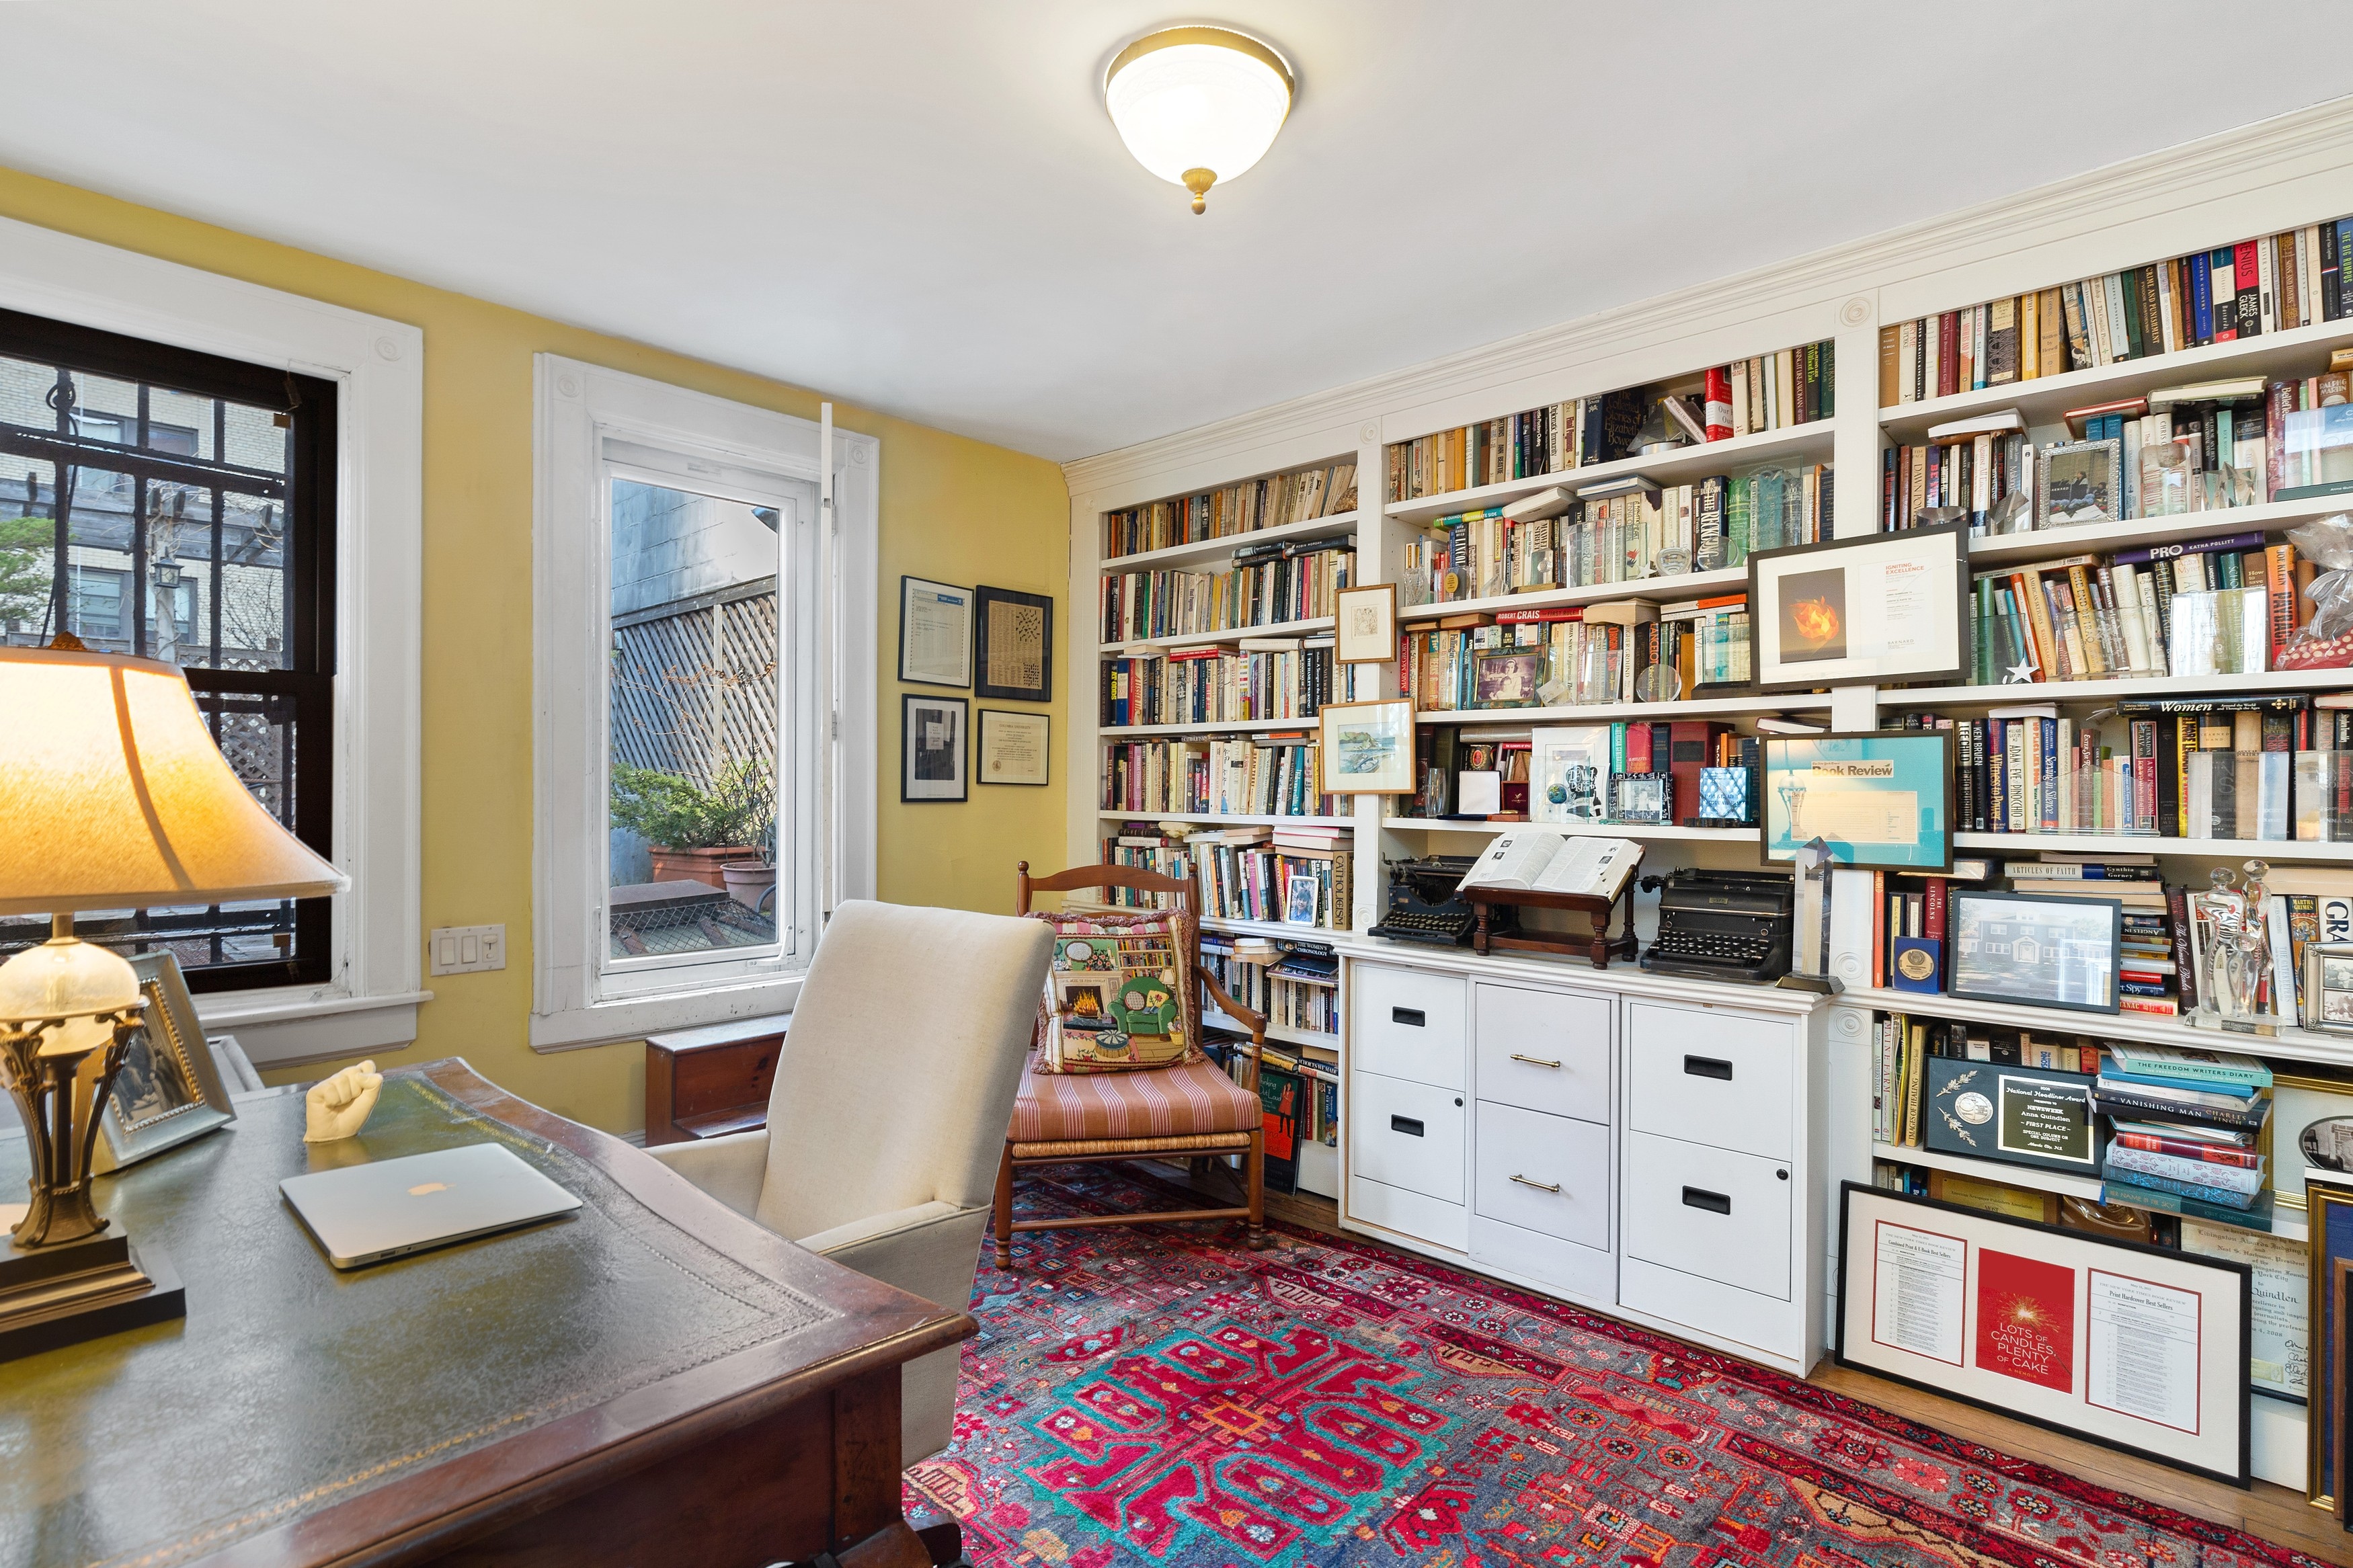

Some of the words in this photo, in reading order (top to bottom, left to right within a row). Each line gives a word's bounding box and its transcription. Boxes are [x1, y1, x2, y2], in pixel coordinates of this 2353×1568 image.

[2342, 231, 2350, 243] THE
[2343, 245, 2351, 257] BIG
[2344, 259, 2352, 284] RUMPUS
[2146, 267, 2154, 288] CRIME
[2150, 304, 2159, 343] PUNISHMENT
[2249, 294, 2258, 317] JAMES
[2321, 385, 2346, 395] MARTIN
[1550, 405, 1558, 430] Diplomatic
[1718, 405, 1729, 414] Our
[1914, 464, 1922, 491] DAWN
[1704, 494, 1714, 511] THE
[1701, 512, 1719, 558] RECKONING
[2151, 544, 2184, 559] PRO
[2276, 550, 2285, 563] JOE
[1886, 566, 1924, 575] EXCELLENCE
[2178, 565, 2201, 574] Myrer
[2276, 565, 2286, 585] KLEIN
[2074, 570, 2083, 587] THE
[2030, 577, 2039, 601] AMERICAN
[2155, 568, 2171, 610] PULITZER
[2077, 590, 2087, 606] END
[1517, 610, 1540, 620] CRAIS
[2034, 602, 2044, 624] SKETCHES
[2273, 591, 2292, 646] PAYBACK
[2084, 622, 2094, 643] IRAQ
[1649, 622, 1659, 665] LANCELOT
[2042, 644, 2053, 670] ISAACSON
[1111, 671, 1117, 680] AT
[2160, 701, 2212, 712] Women
[1960, 725, 1969, 737] LEE
[1974, 727, 1982, 741] KEN
[1960, 738, 1970, 762] CHILD
[1974, 743, 1983, 766] BRUEN
[2009, 745, 2020, 763] ADAM
[1812, 766, 1845, 776] Book
[1848, 766, 1892, 776] Review
[1990, 754, 2003, 786] Witness
[2010, 769, 2022, 780] EVE
[2043, 755, 2056, 782] Serving
[1991, 795, 2003, 820] Power
[2011, 784, 2022, 817] PINOCCHIO
[2046, 788, 2057, 814] Silence
[1335, 855, 1344, 925] CATHOLICISM
[2176, 922, 2187, 937] The
[1297, 947, 1328, 956] CHRONOLOGY
[2177, 938, 2189, 964] Woman
[2179, 966, 2191, 991] Reader
[2126, 985, 2142, 996] Spy
[2193, 1068, 2226, 1076] WRITERS
[1911, 1078, 1919, 1107] HEALING
[2006, 1087, 2032, 1096] National
[2034, 1091, 2064, 1100] Headliner
[1910, 1108, 1917, 1116] OF
[2028, 1105, 2063, 1114] NEWSWEEK
[2120, 1098, 2174, 1112] VANISHING
[2040, 1114, 2071, 1122] Quindlen
[2206, 1110, 2247, 1120] CHARLES
[2213, 1116, 2241, 1125] FINCH
[1908, 1116, 1917, 1140] IMAGES
[2122, 1293, 2145, 1303] Hardcover
[2157, 1303, 2173, 1311] Sellers
[2251, 1288, 2300, 1304] Quindlen
[2000, 1323, 2032, 1338] LOTS
[1991, 1331, 2056, 1356] CANDLES,
[1998, 1343, 2048, 1363] PLENTY
[2012, 1358, 2048, 1374] CAKE
[2014, 1370, 2037, 1378] MEMOIR
